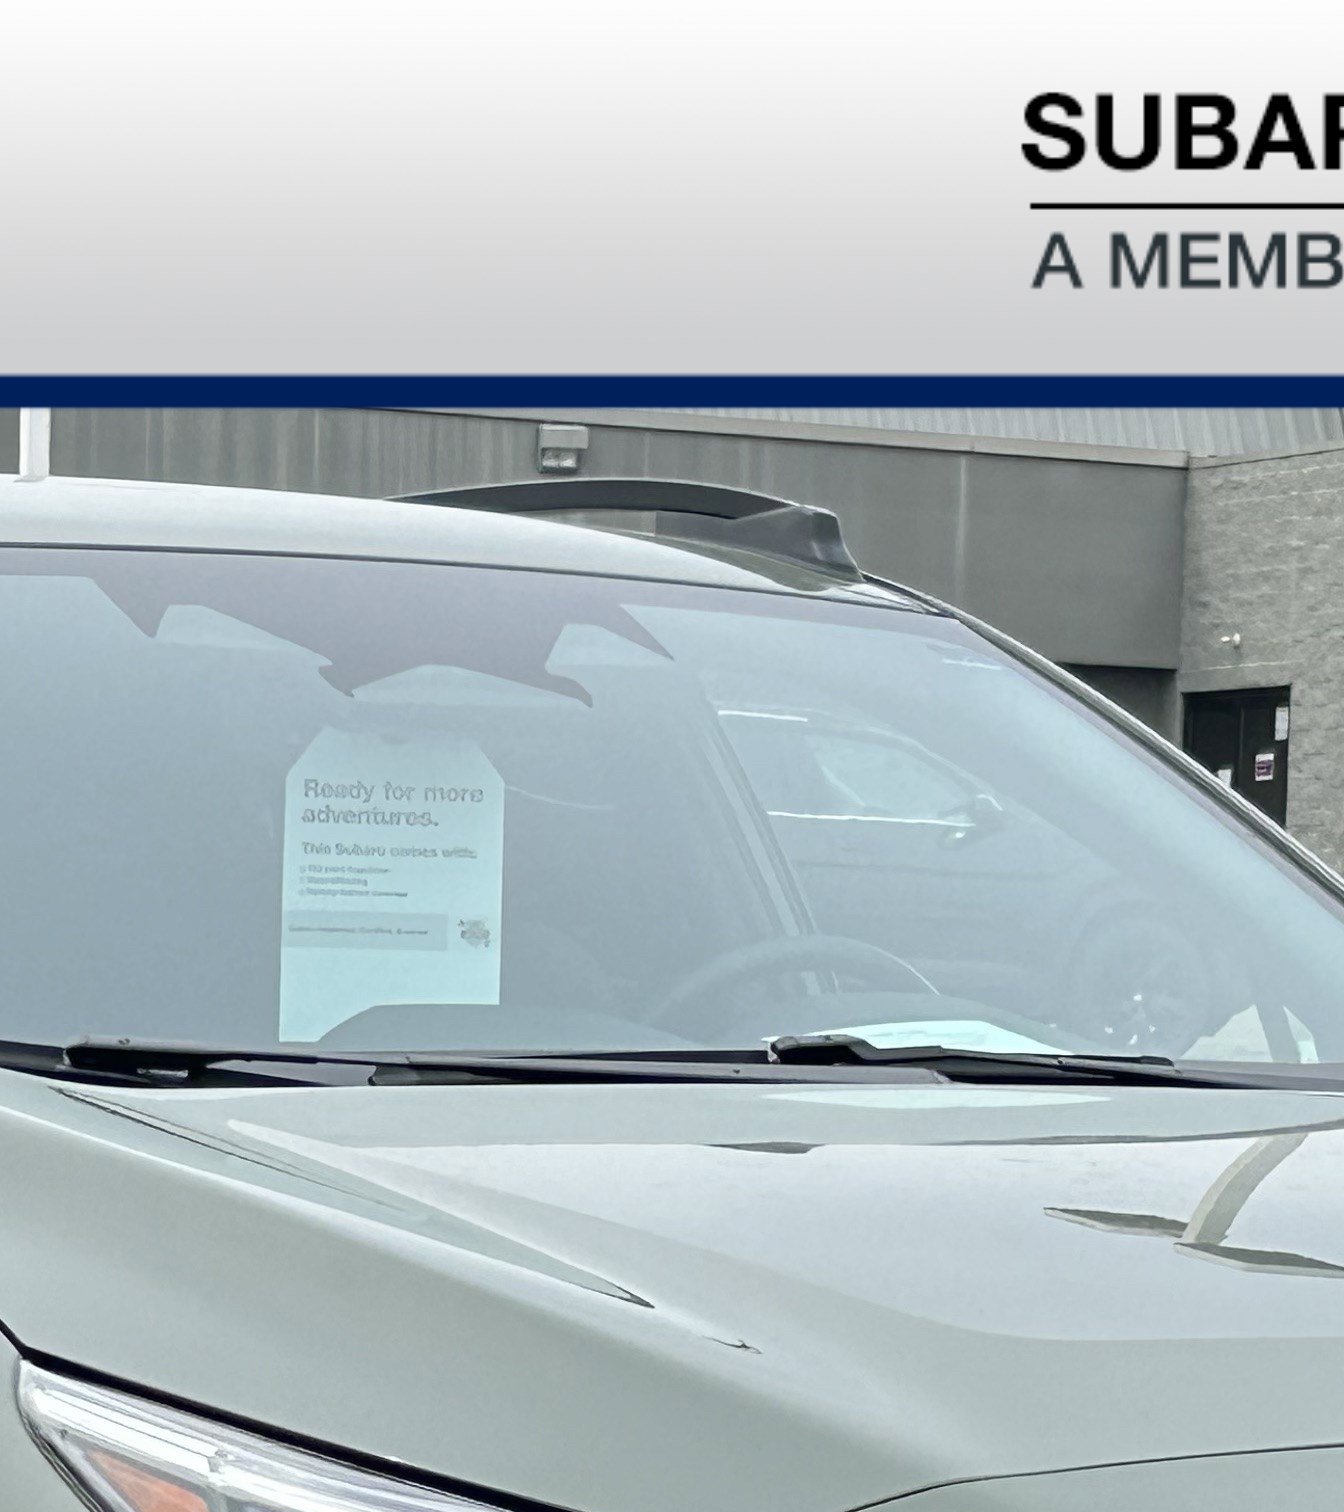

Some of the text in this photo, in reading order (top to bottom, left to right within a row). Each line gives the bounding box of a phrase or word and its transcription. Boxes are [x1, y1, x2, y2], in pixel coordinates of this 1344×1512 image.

[304, 778, 484, 803] Ready for more
